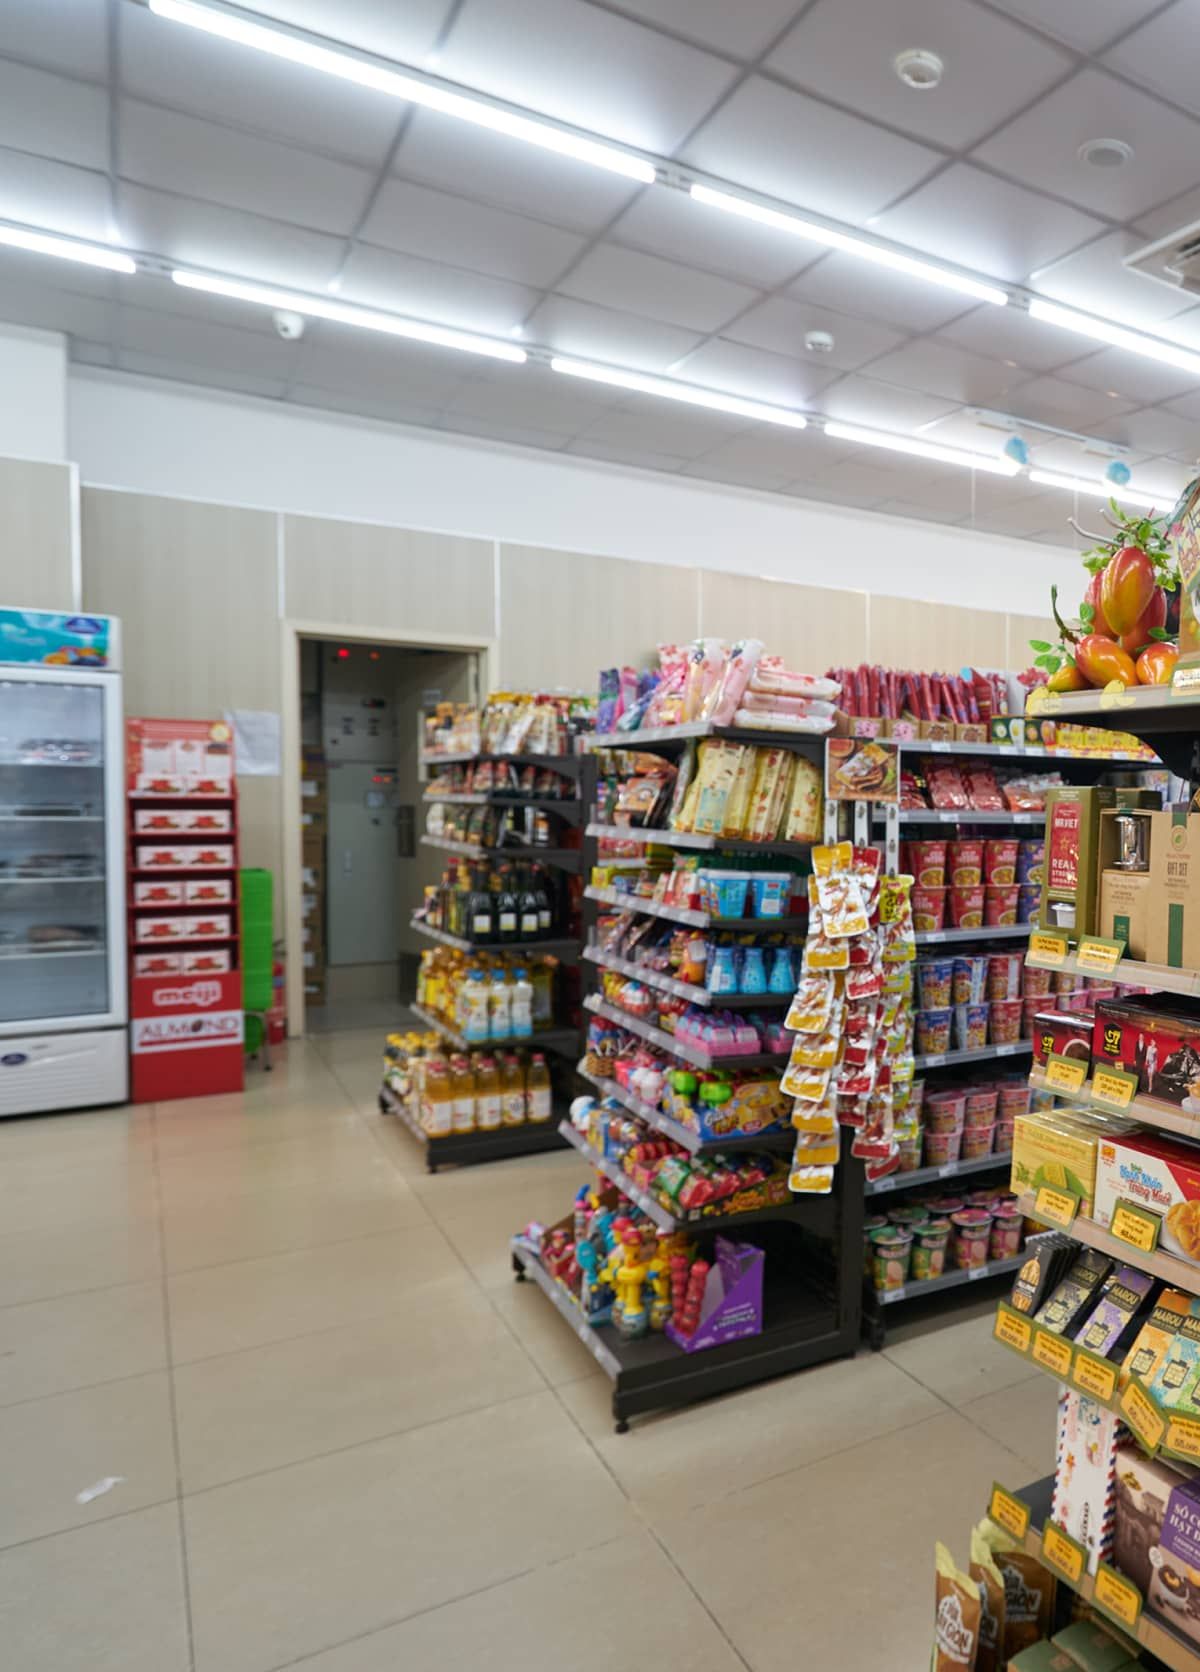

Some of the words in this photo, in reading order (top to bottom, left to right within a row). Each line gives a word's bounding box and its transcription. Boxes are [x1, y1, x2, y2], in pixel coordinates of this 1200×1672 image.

[153, 981, 221, 1006] meiji
[139, 1015, 239, 1041] ALMOND
[1112, 1284, 1138, 1305] MAROU
[1153, 1307, 1182, 1327] MAROU
[1174, 1503, 1188, 1519] SÔ
[1170, 1514, 1191, 1536] HẠT
